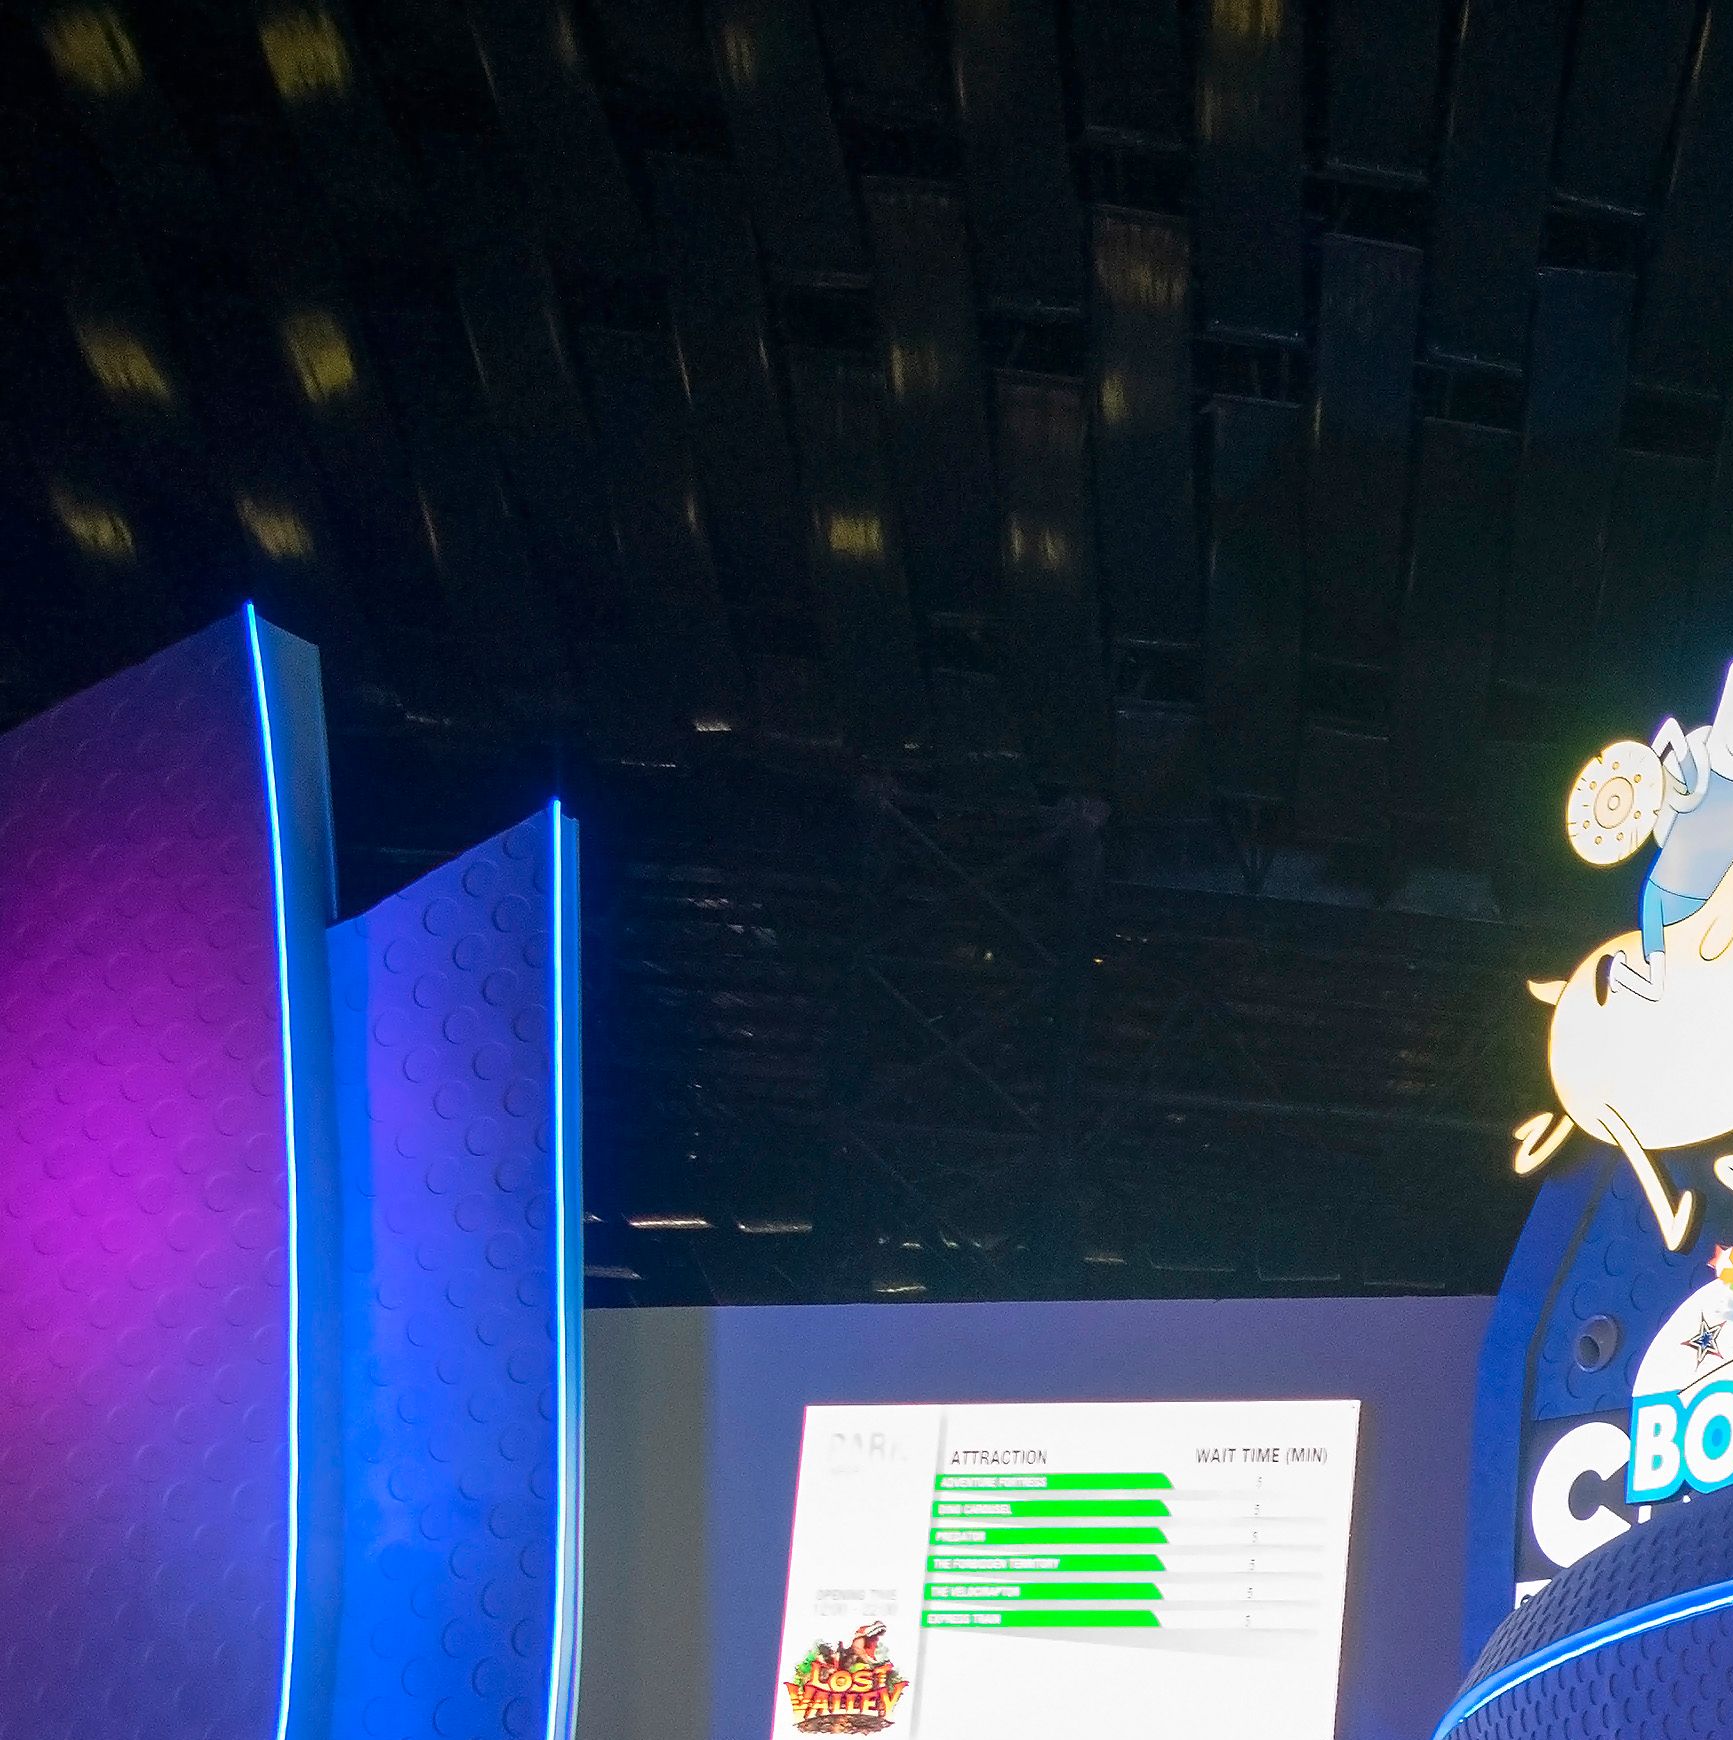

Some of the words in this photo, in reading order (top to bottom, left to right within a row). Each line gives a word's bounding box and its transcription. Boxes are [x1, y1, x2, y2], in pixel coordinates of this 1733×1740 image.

[951, 1450, 1047, 1465] ATTRACTION
[1195, 1448, 1236, 1462] WAIT
[1242, 1448, 1279, 1462] TIME
[1286, 1447, 1328, 1465] (MIN)
[809, 1661, 894, 1693] LOST
[784, 1681, 909, 1719] VALLEY
